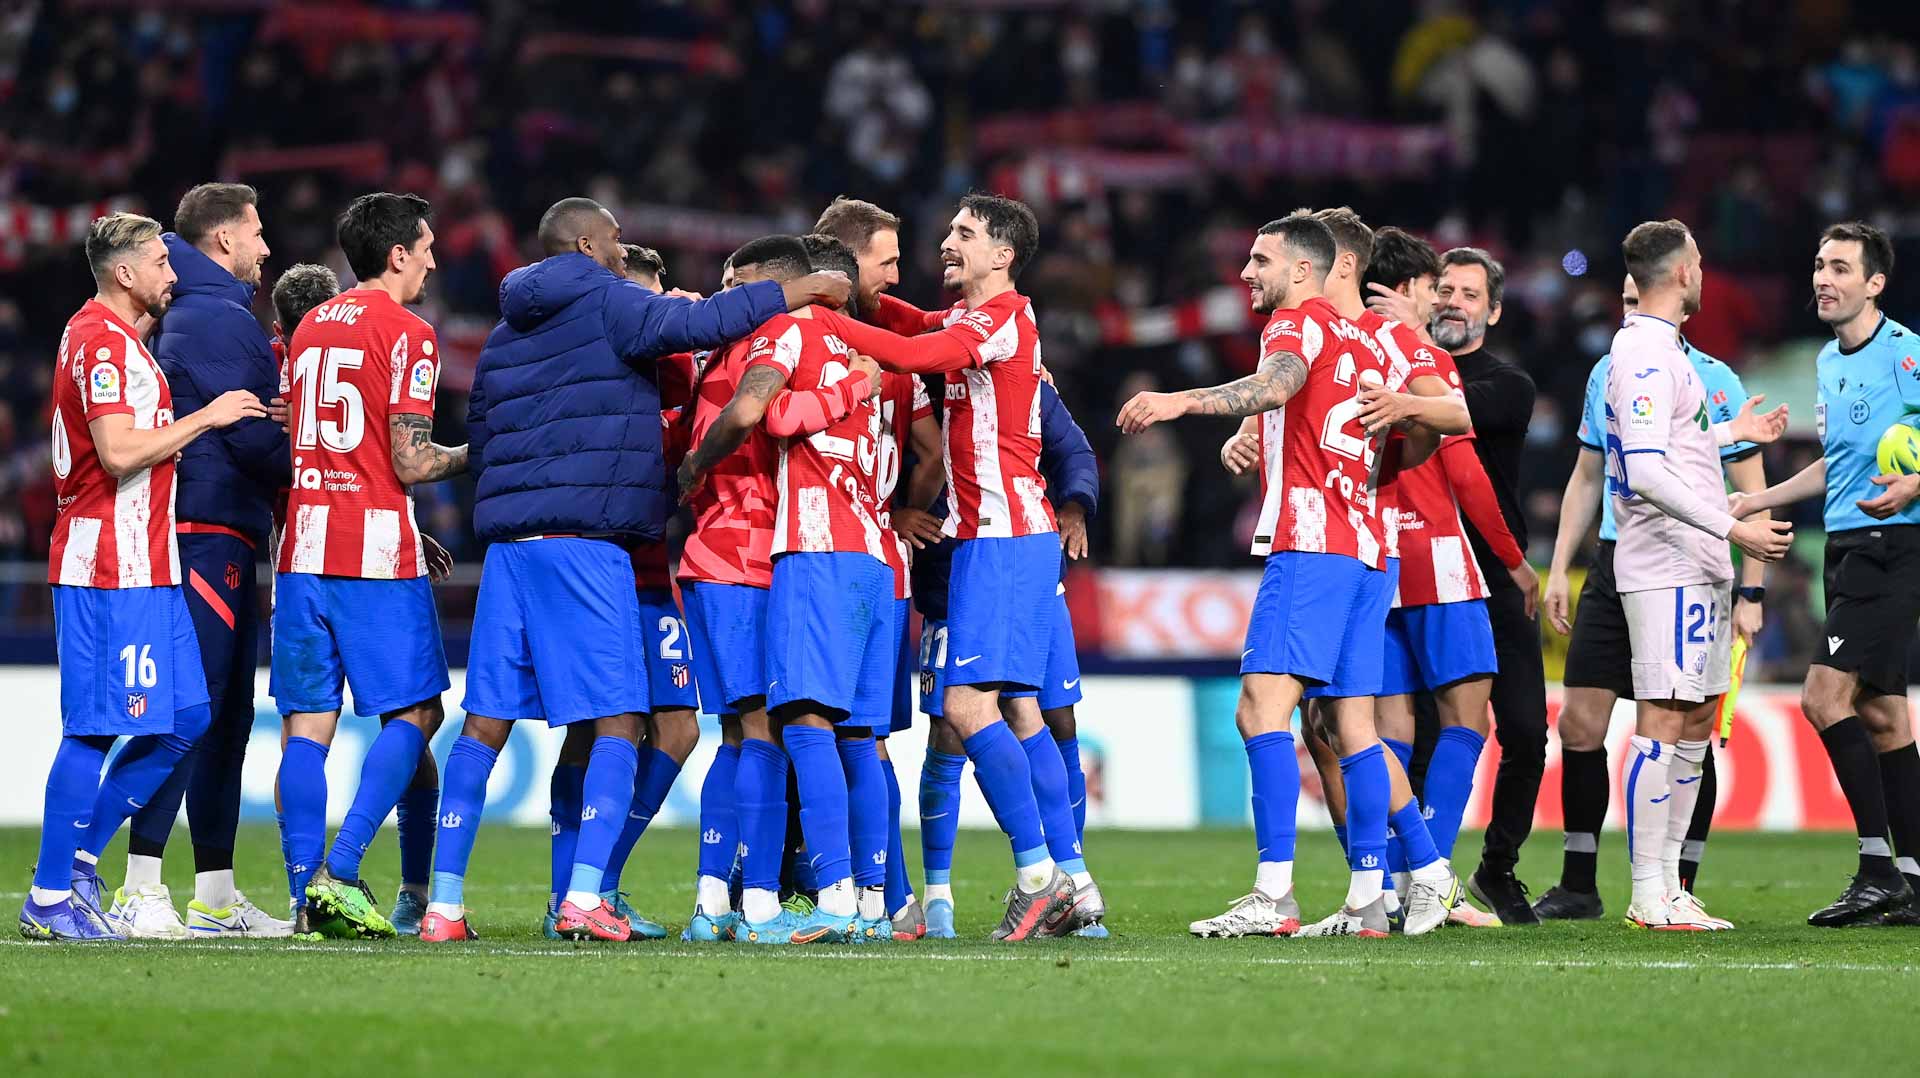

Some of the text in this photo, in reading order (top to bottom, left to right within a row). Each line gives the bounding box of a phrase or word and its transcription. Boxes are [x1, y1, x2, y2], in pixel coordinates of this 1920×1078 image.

[315, 303, 367, 325] SAVIĆ
[94, 390, 117, 398] LaLiga
[293, 346, 365, 453] 15
[293, 456, 322, 490] ia
[324, 469, 357, 482] Money
[324, 481, 362, 492] Transfer
[658, 616, 694, 661] 2
[119, 644, 157, 688] 16
